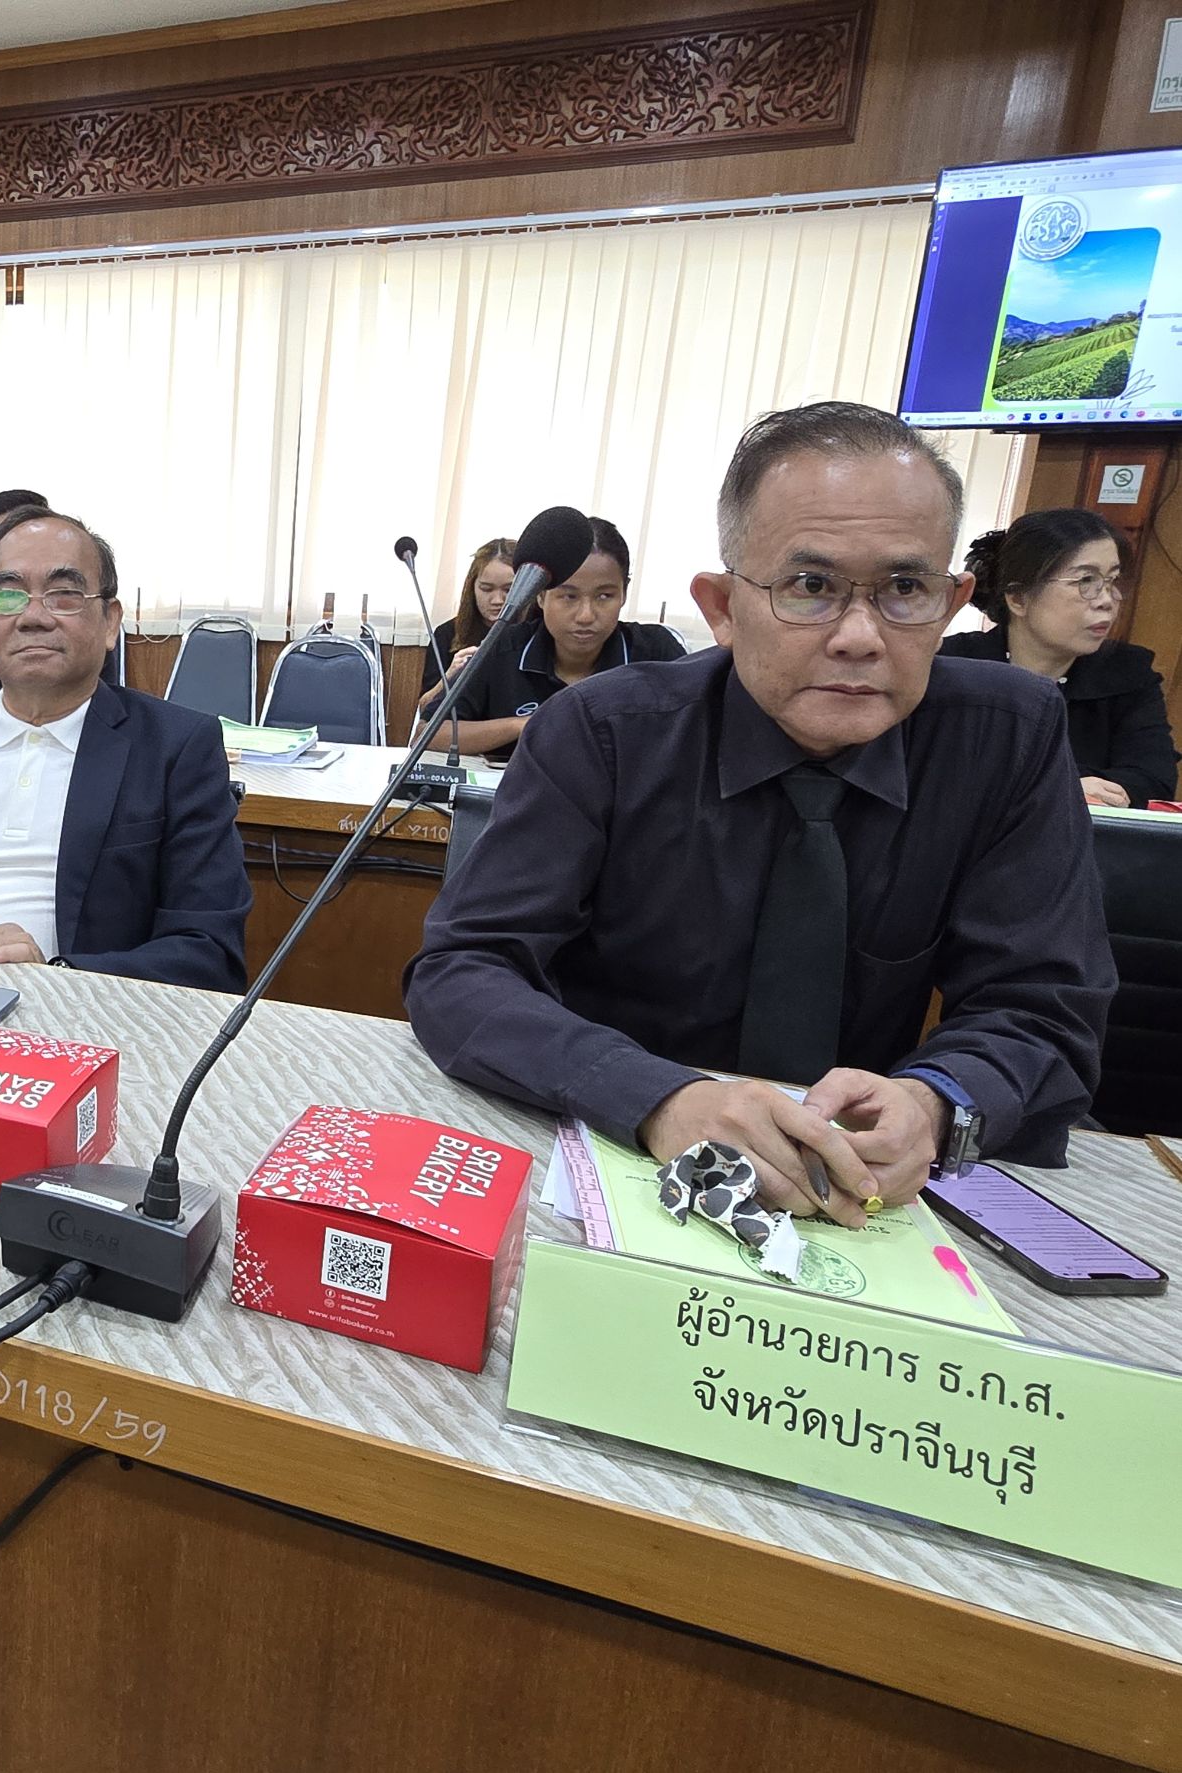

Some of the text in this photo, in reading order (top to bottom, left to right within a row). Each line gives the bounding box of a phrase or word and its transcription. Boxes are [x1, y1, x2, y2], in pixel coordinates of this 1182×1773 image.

[409, 1133, 470, 1208] BAKERY
[452, 1145, 503, 1199] SRIFA
[308, 1309, 395, 1338] www.srifabakery.co.th
[675, 1286, 1066, 1421] ผู้อำนวยการ ธ.ก.ส.
[691, 1366, 1037, 1506] จังหวัดปราจีนบุรี
